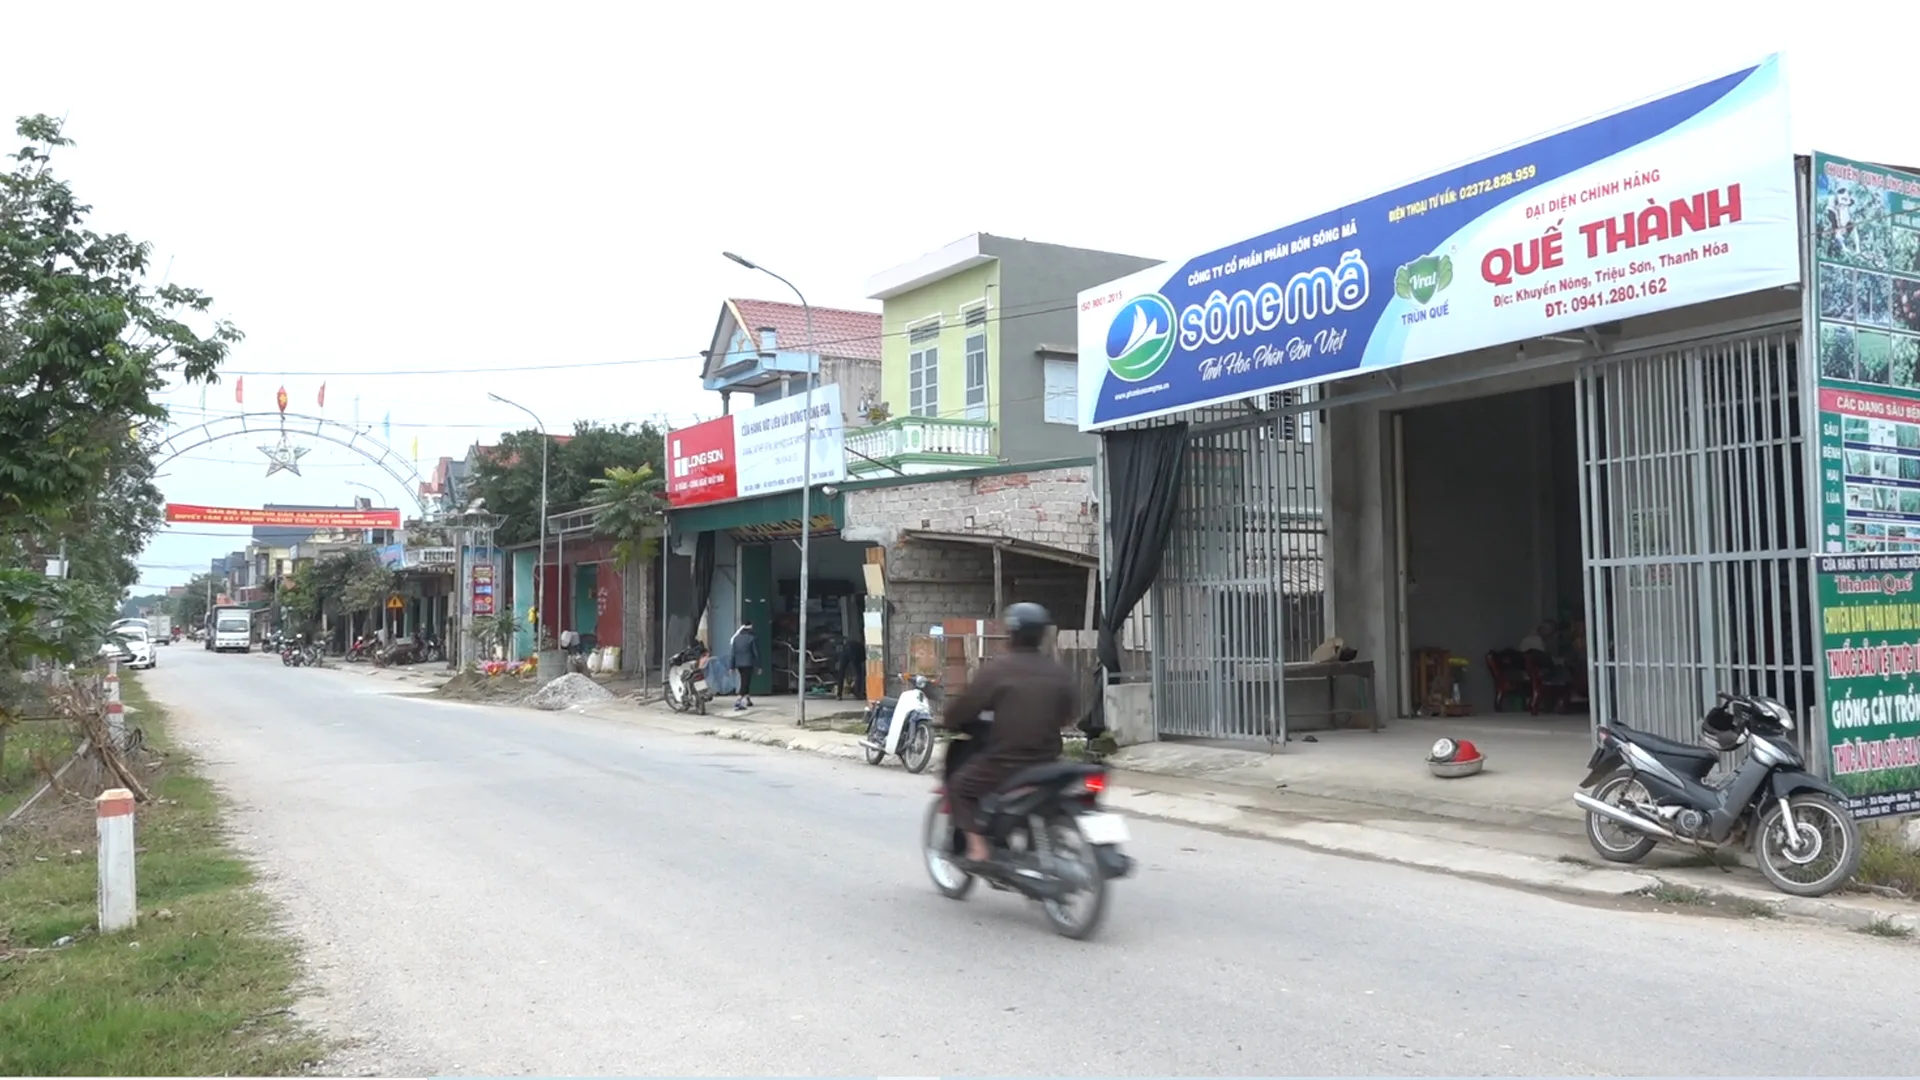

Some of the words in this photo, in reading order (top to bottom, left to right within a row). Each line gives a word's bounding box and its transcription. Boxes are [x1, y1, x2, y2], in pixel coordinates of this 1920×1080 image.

[1406, 199, 1428, 216] THOẠI
[1459, 164, 1537, 200] 02372.828.959
[1525, 203, 1545, 220] ĐẠI
[1548, 193, 1577, 213] DIỆN
[1580, 181, 1620, 203] CHÍNH
[1187, 269, 1211, 287] CÔNG
[1212, 264, 1224, 280] TY
[1264, 243, 1289, 263] PHÂN
[1290, 236, 1311, 254] BÓN
[1312, 229, 1339, 248] SÔNG
[1341, 218, 1358, 238] MÃ
[1481, 218, 1565, 287] QUẾ
[1579, 182, 1742, 259] THÀNH
[1558, 276, 1592, 293] Nông,
[1595, 266, 1626, 284] Triệu
[1628, 260, 1656, 276] Sơn,
[1658, 248, 1699, 268] Thanh
[1702, 242, 1729, 258] Hóa
[1401, 307, 1428, 325] TRÙN
[1429, 299, 1450, 319] QUẾ
[1545, 300, 1568, 318] ĐT:
[1571, 277, 1667, 312] 0941.280.162
[1223, 351, 1252, 375] Hoa
[1252, 343, 1284, 370] Phân
[1313, 327, 1348, 355] Việt
[1836, 395, 1856, 411] CÁC
[1857, 400, 1885, 416] DẠNG
[1885, 401, 1904, 417] SÂU
[1825, 638, 1857, 679] THUỐC
[1832, 687, 1870, 729] GIỐNG
[1871, 690, 1893, 726] CÂY
